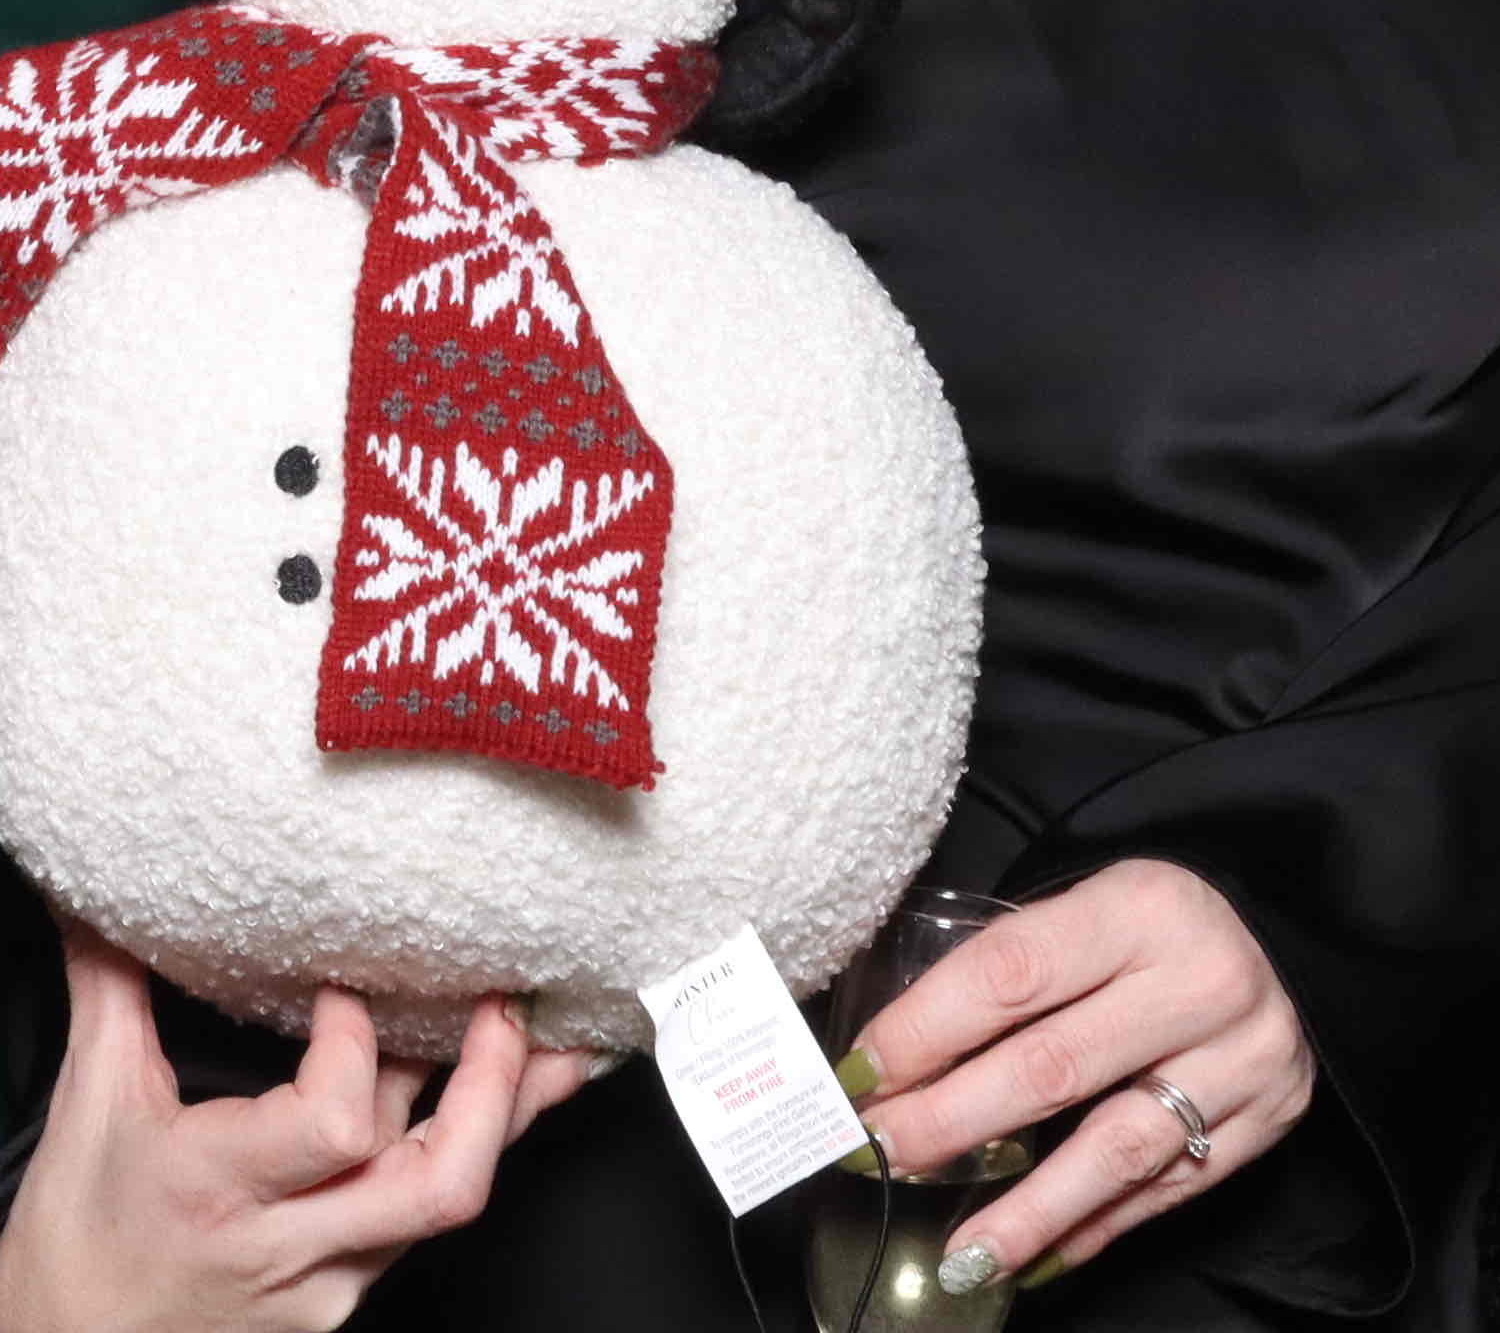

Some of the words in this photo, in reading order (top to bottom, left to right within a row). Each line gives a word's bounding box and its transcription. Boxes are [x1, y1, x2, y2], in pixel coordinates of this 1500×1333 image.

[713, 1076, 745, 1100] KEEP
[742, 1056, 779, 1084] AWAY
[721, 1086, 758, 1114] FROM
[756, 1071, 786, 1095] FIRE
